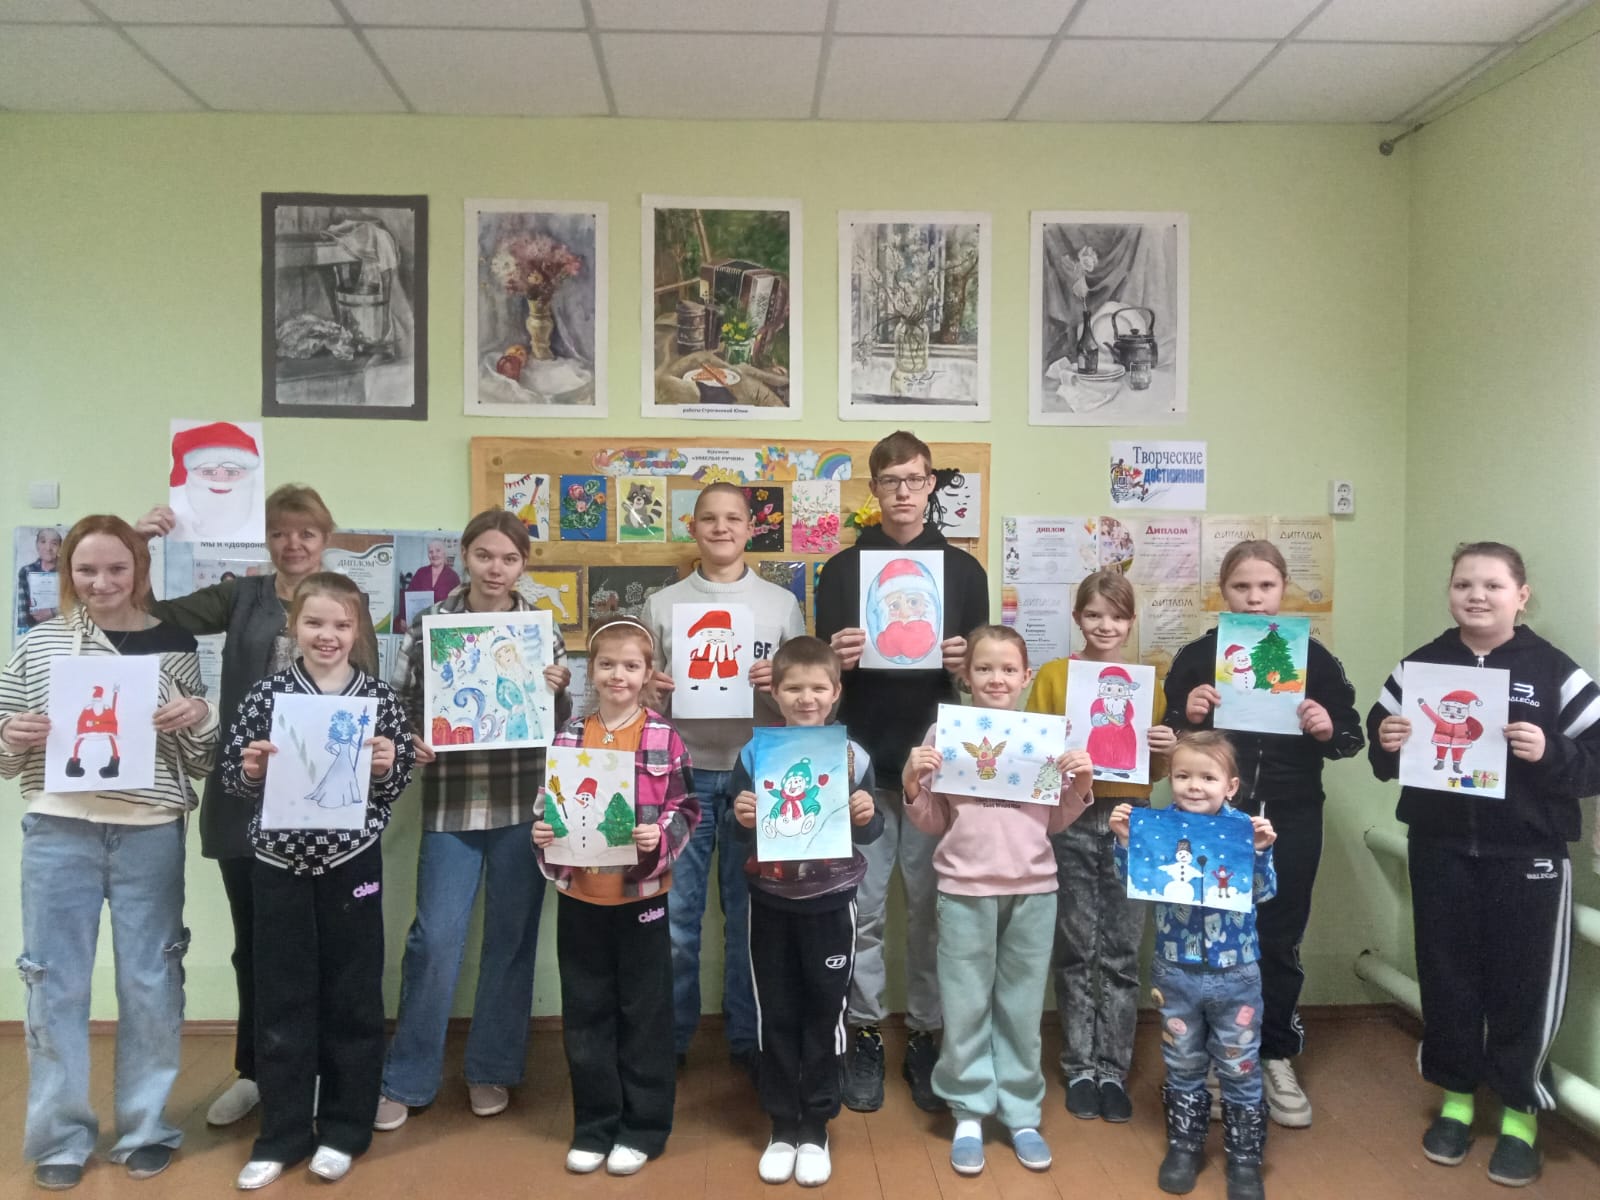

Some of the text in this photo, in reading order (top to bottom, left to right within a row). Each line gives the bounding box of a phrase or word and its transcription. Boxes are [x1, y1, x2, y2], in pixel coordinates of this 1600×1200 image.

[1132, 445, 1204, 469] Творческие
[337, 558, 376, 569] ДИПЛОМ
[1151, 597, 1194, 608] ДИПЛОМ
